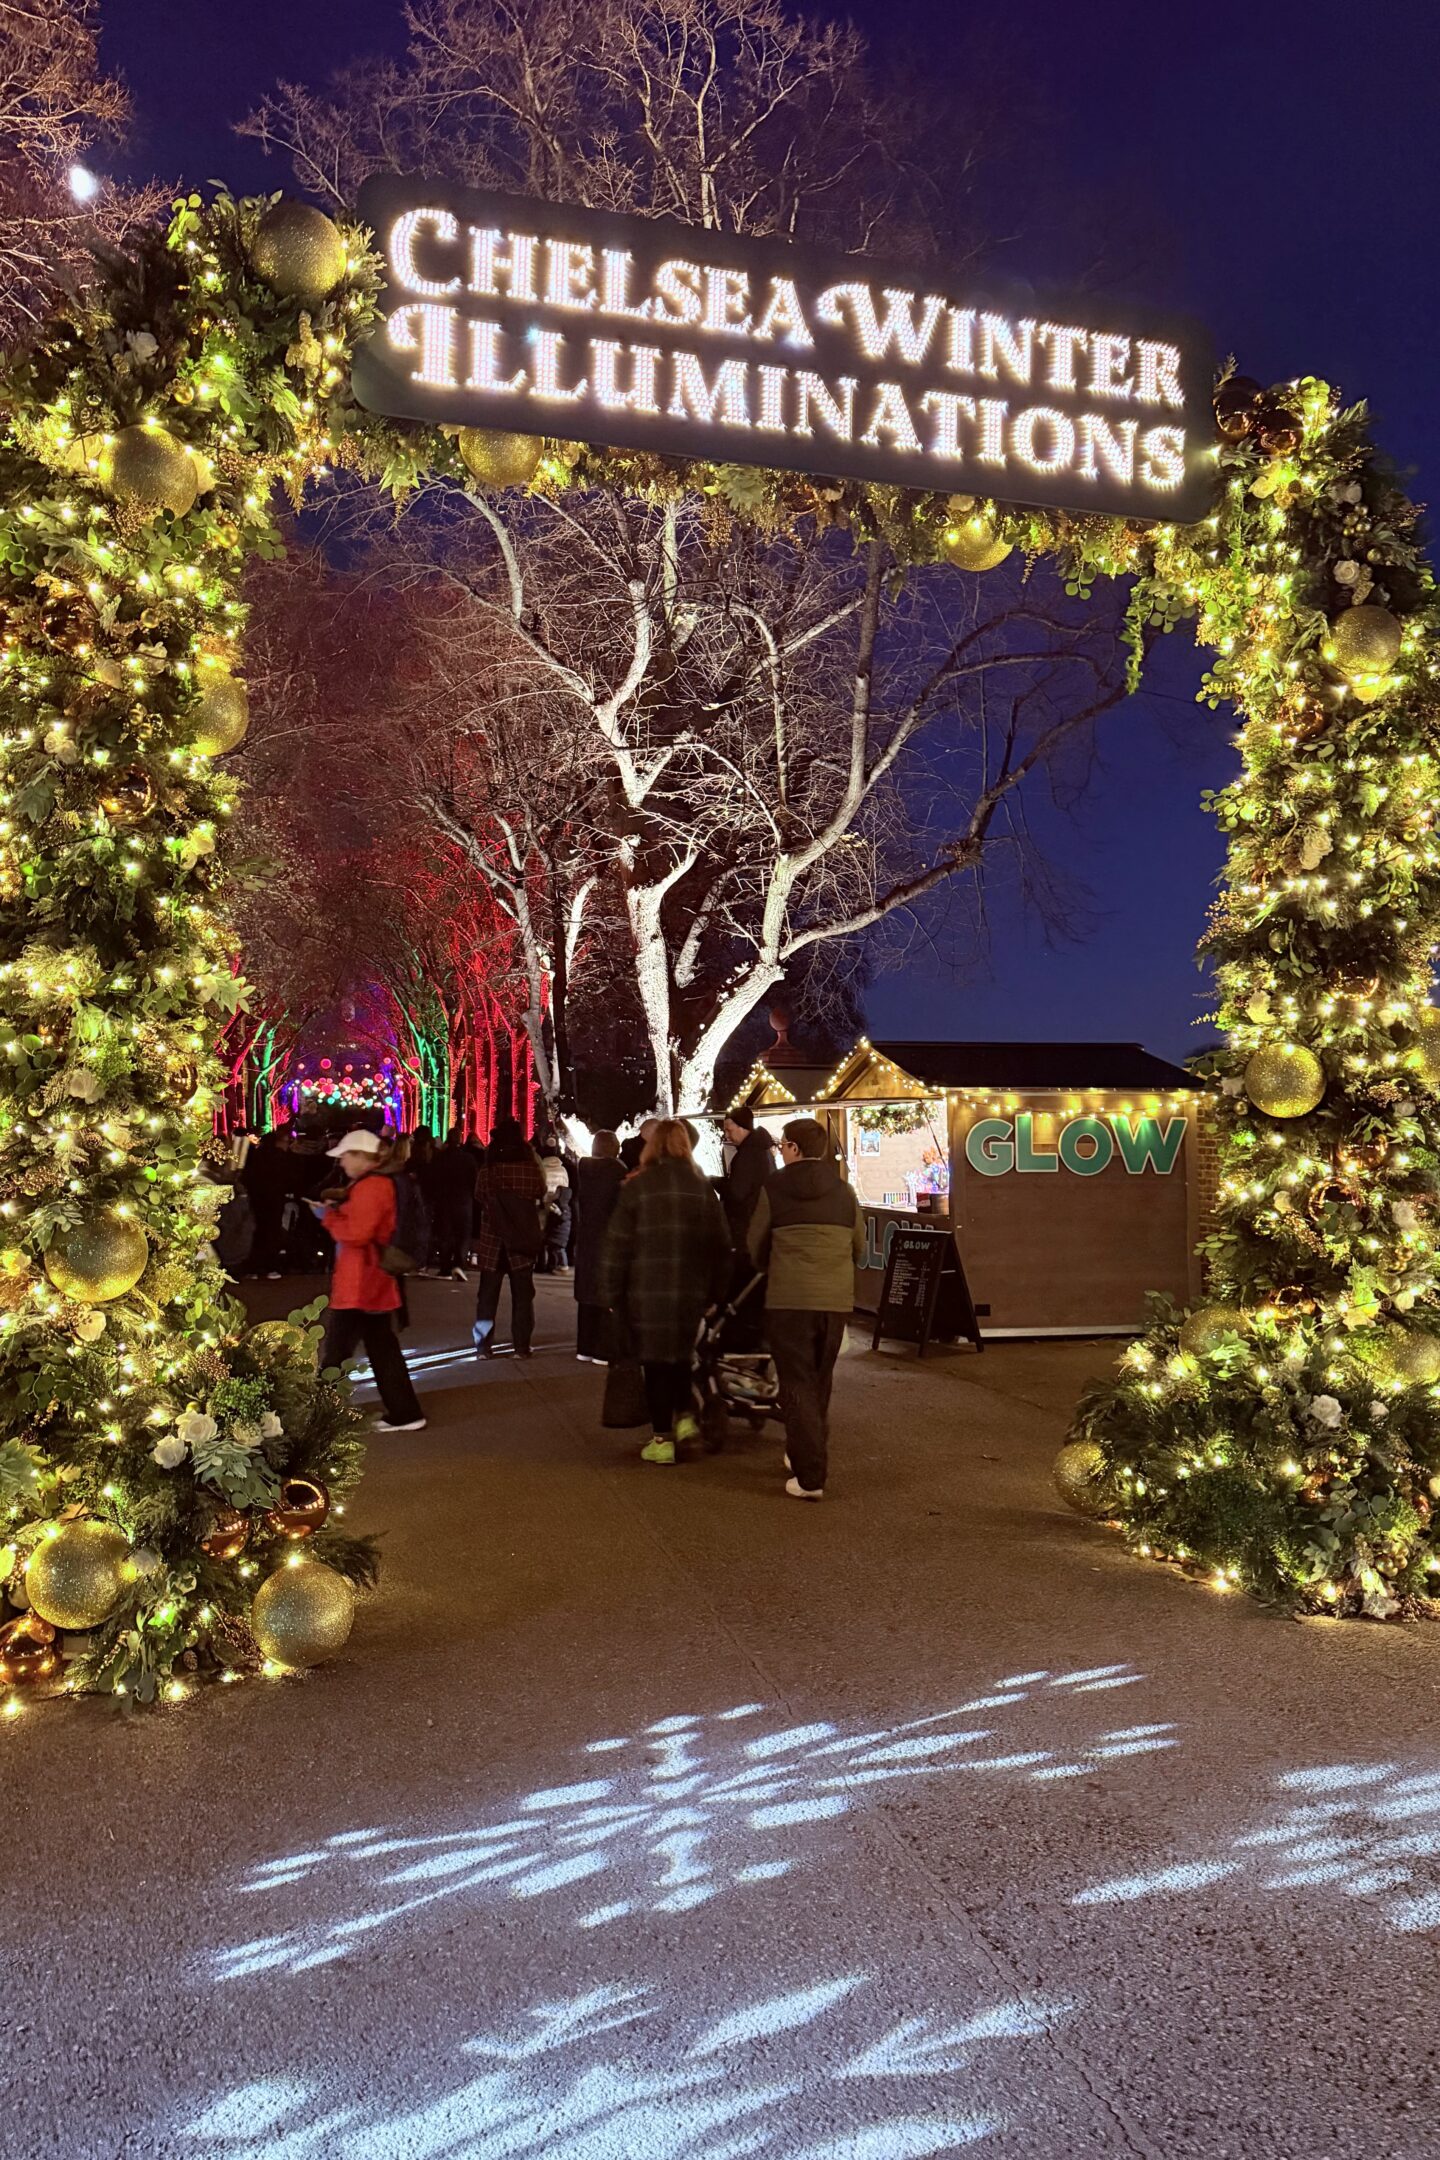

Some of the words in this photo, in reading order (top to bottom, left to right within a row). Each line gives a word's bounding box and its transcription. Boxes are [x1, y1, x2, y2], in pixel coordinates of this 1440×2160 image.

[386, 302, 1188, 491] ILLUMINATIONS
[387, 207, 816, 348] CHELSEA
[817, 281, 1187, 406] WINTER
[965, 1114, 1188, 1176] GLOW
